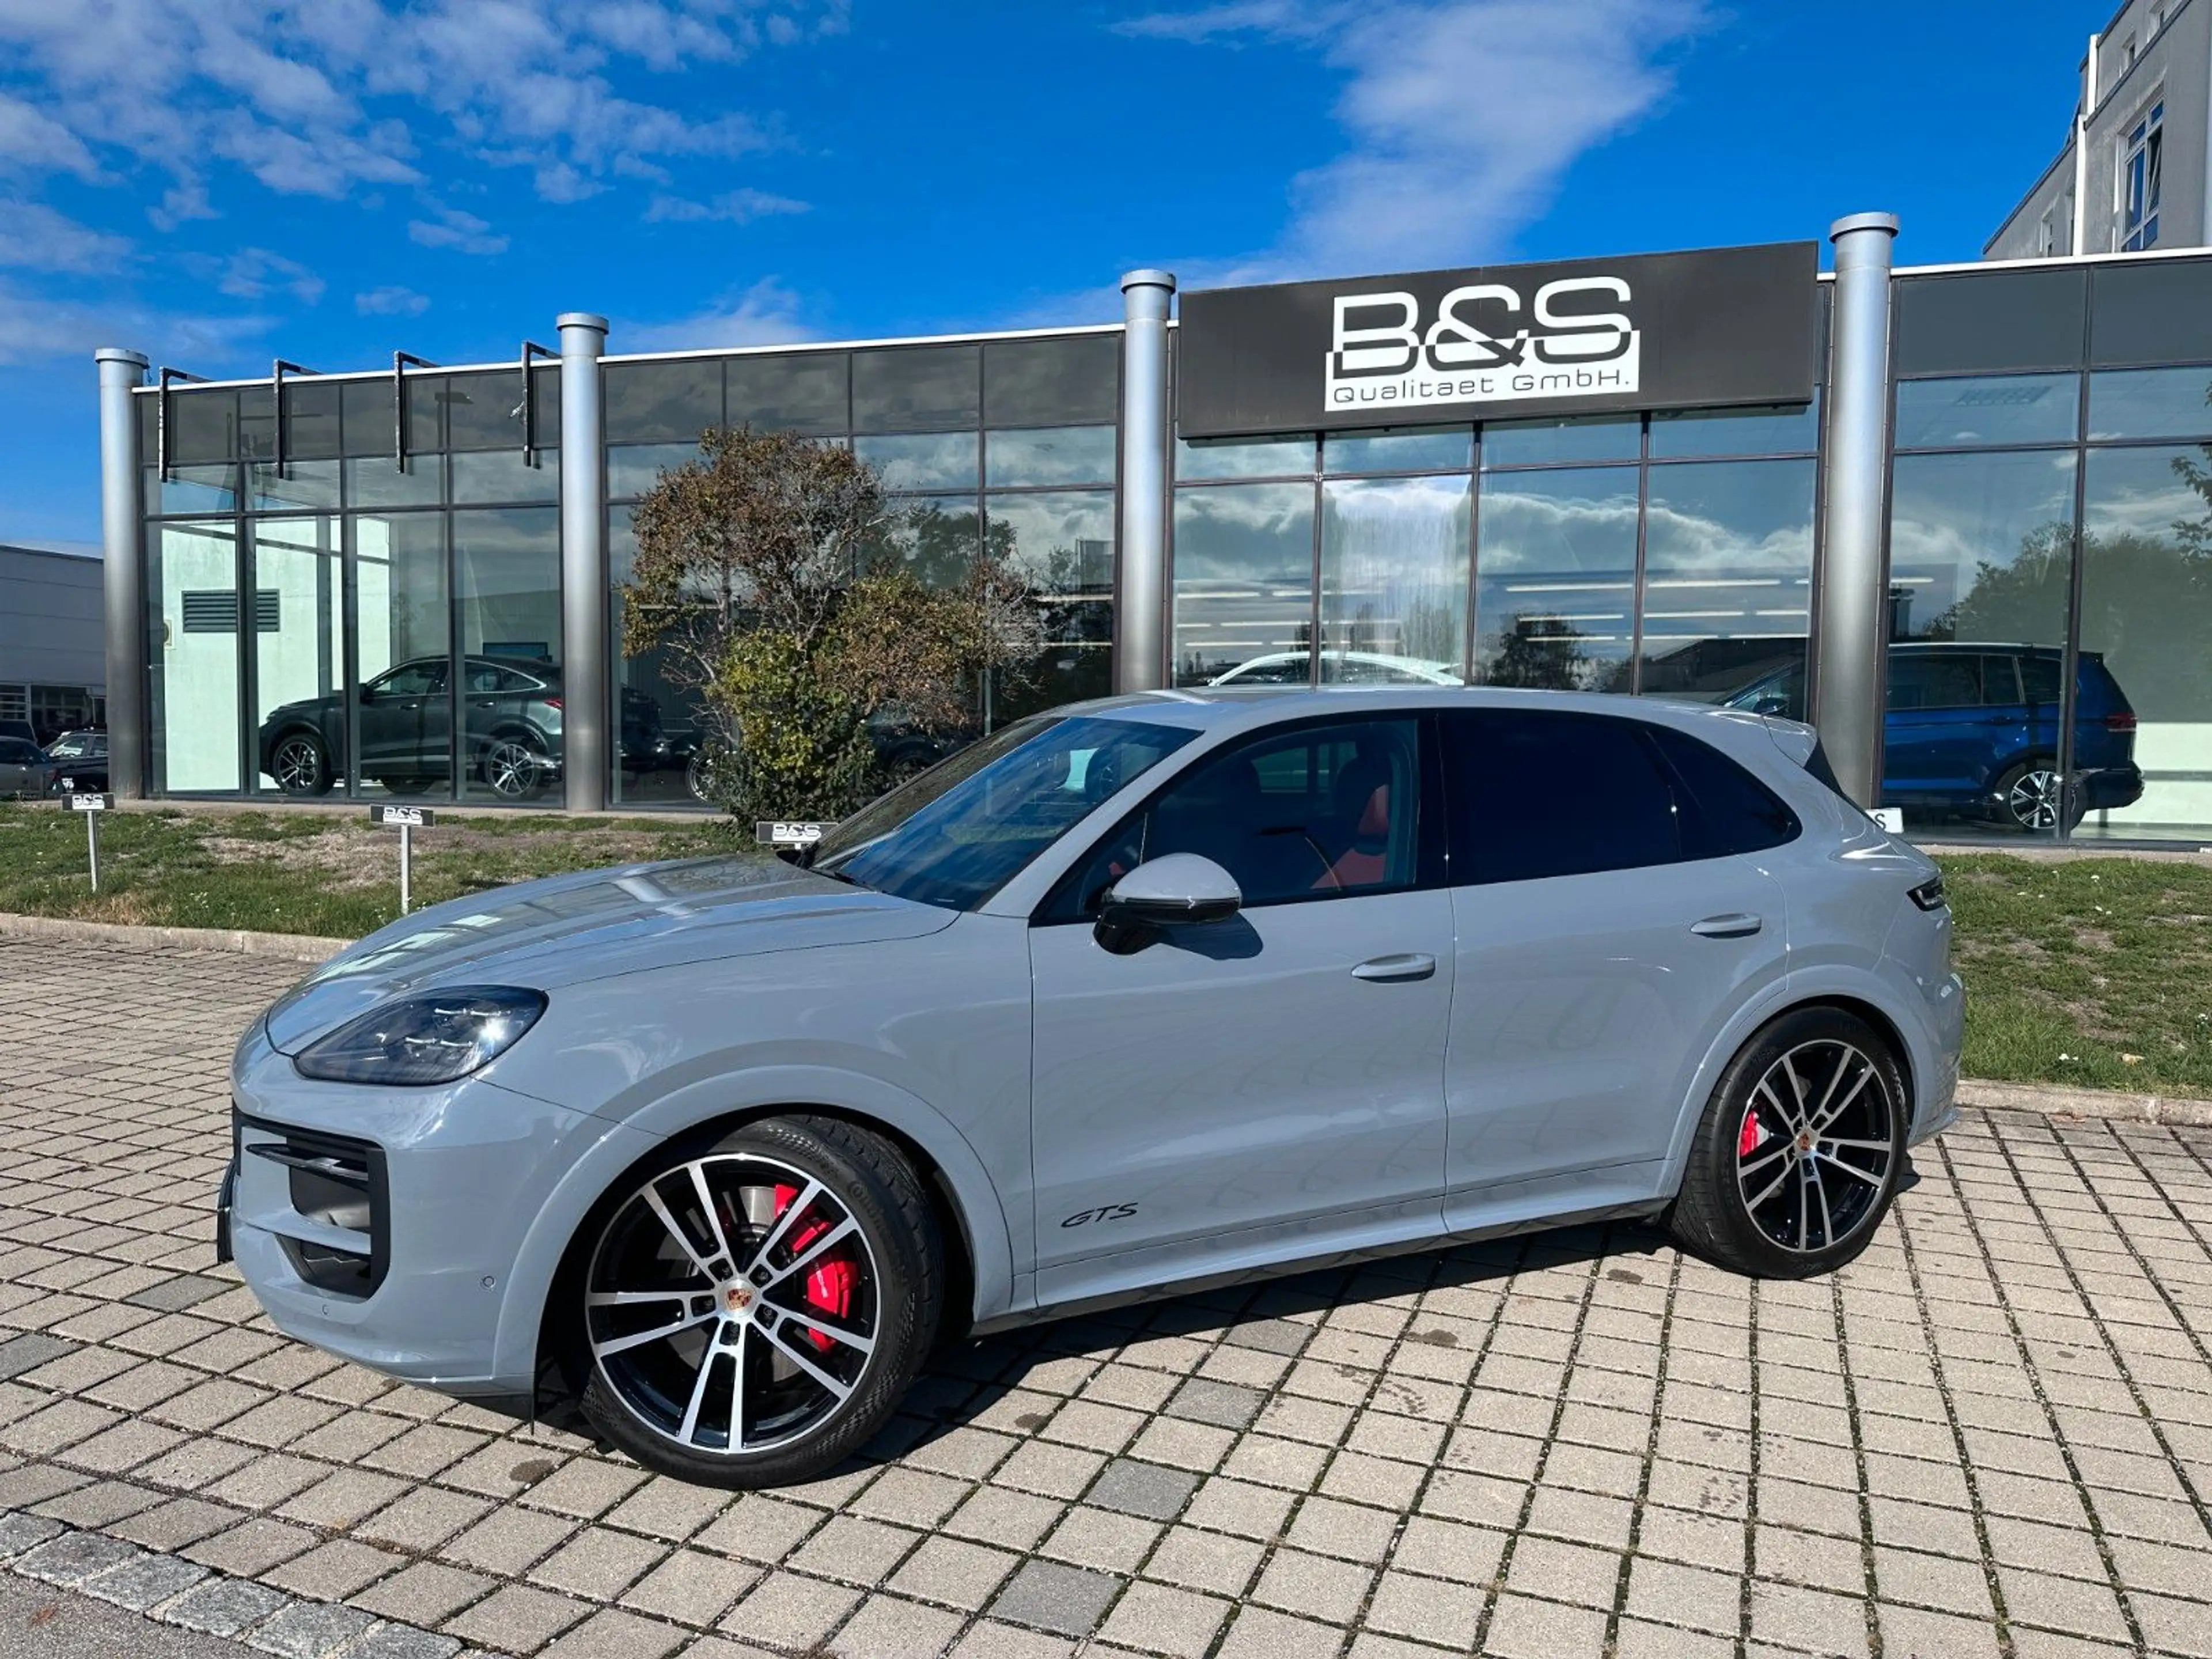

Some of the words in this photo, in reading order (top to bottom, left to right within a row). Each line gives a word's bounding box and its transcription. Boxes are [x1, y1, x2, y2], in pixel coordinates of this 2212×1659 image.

[1333, 276, 1633, 380] B&S
[1334, 377, 1494, 403] Qualitaet
[1512, 369, 1630, 392] GmbH.
[384, 807, 421, 820] B&S
[773, 824, 821, 837] B&S
[1060, 1202, 1139, 1228] GTS
